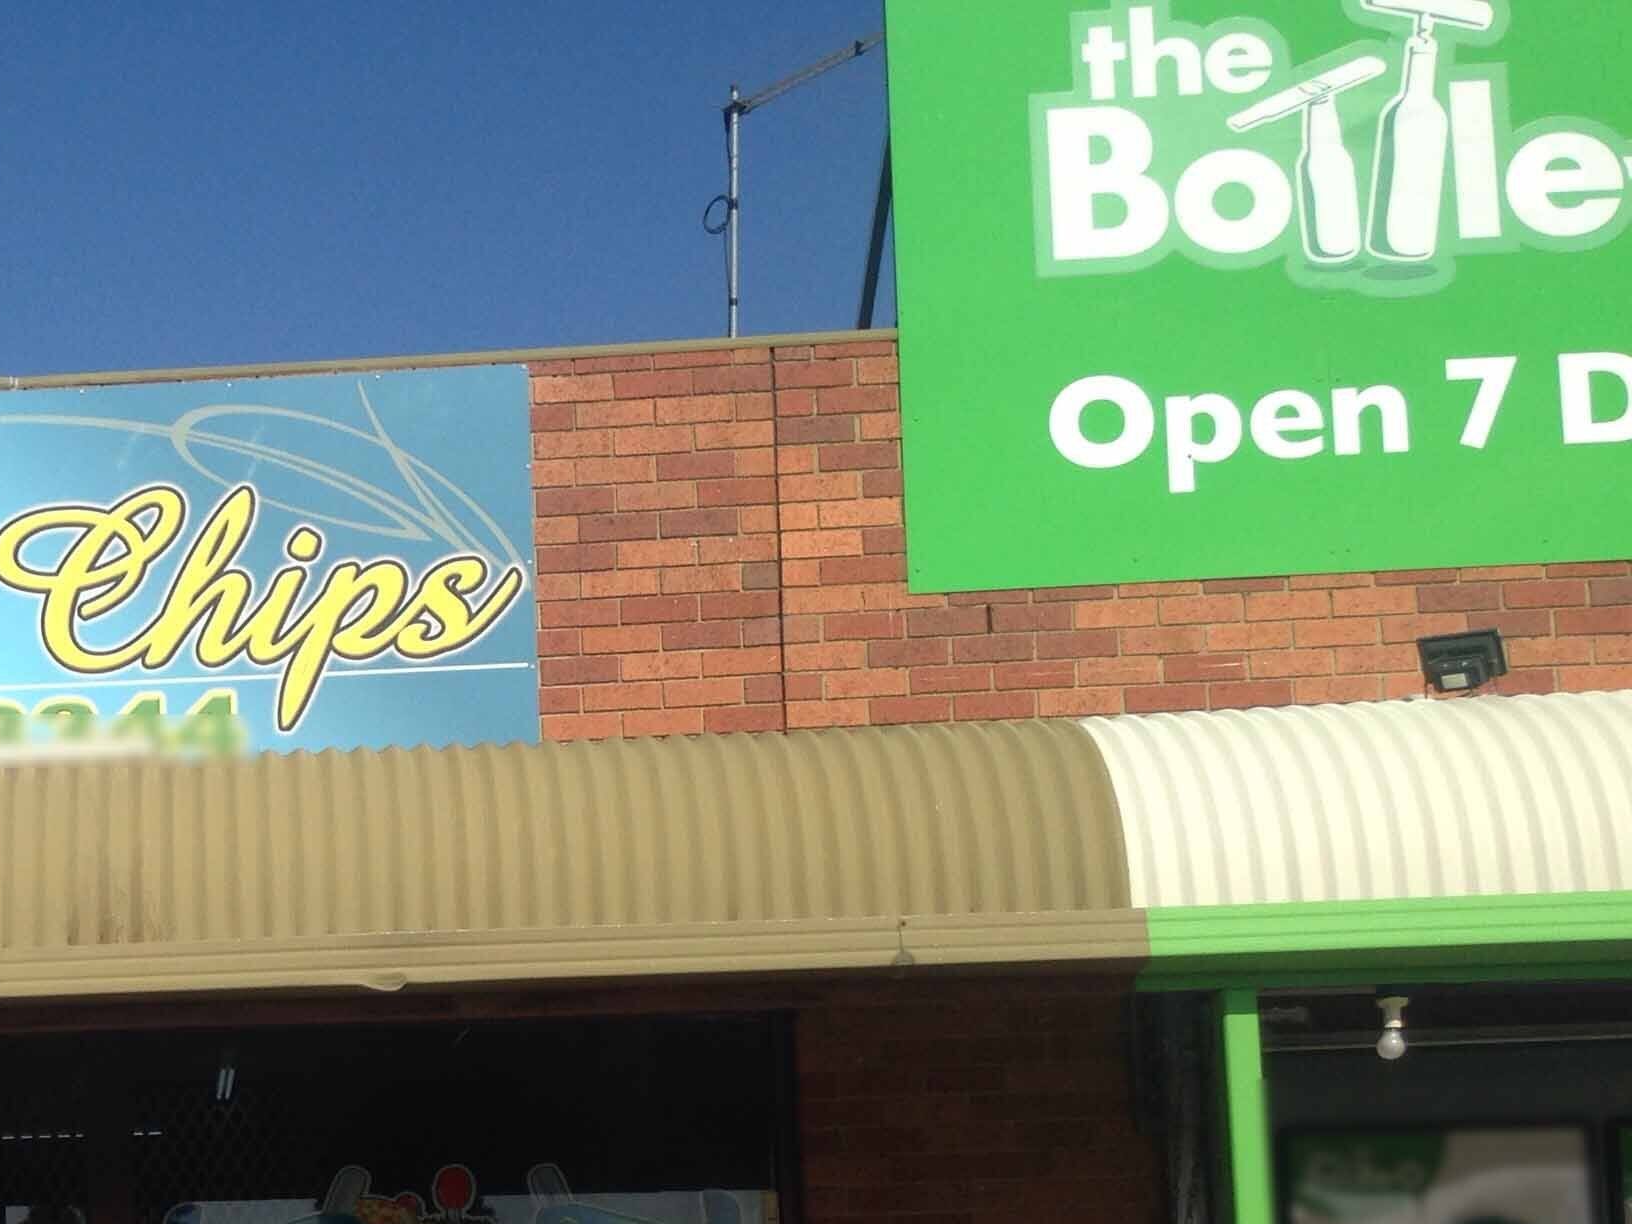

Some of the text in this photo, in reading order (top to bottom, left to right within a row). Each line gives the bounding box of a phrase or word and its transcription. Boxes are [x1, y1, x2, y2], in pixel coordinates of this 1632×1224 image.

[1082, 6, 1273, 100] the
[1047, 40, 1632, 263] Bottle
[1049, 374, 1409, 494] Open
[1445, 356, 1518, 450] 7
